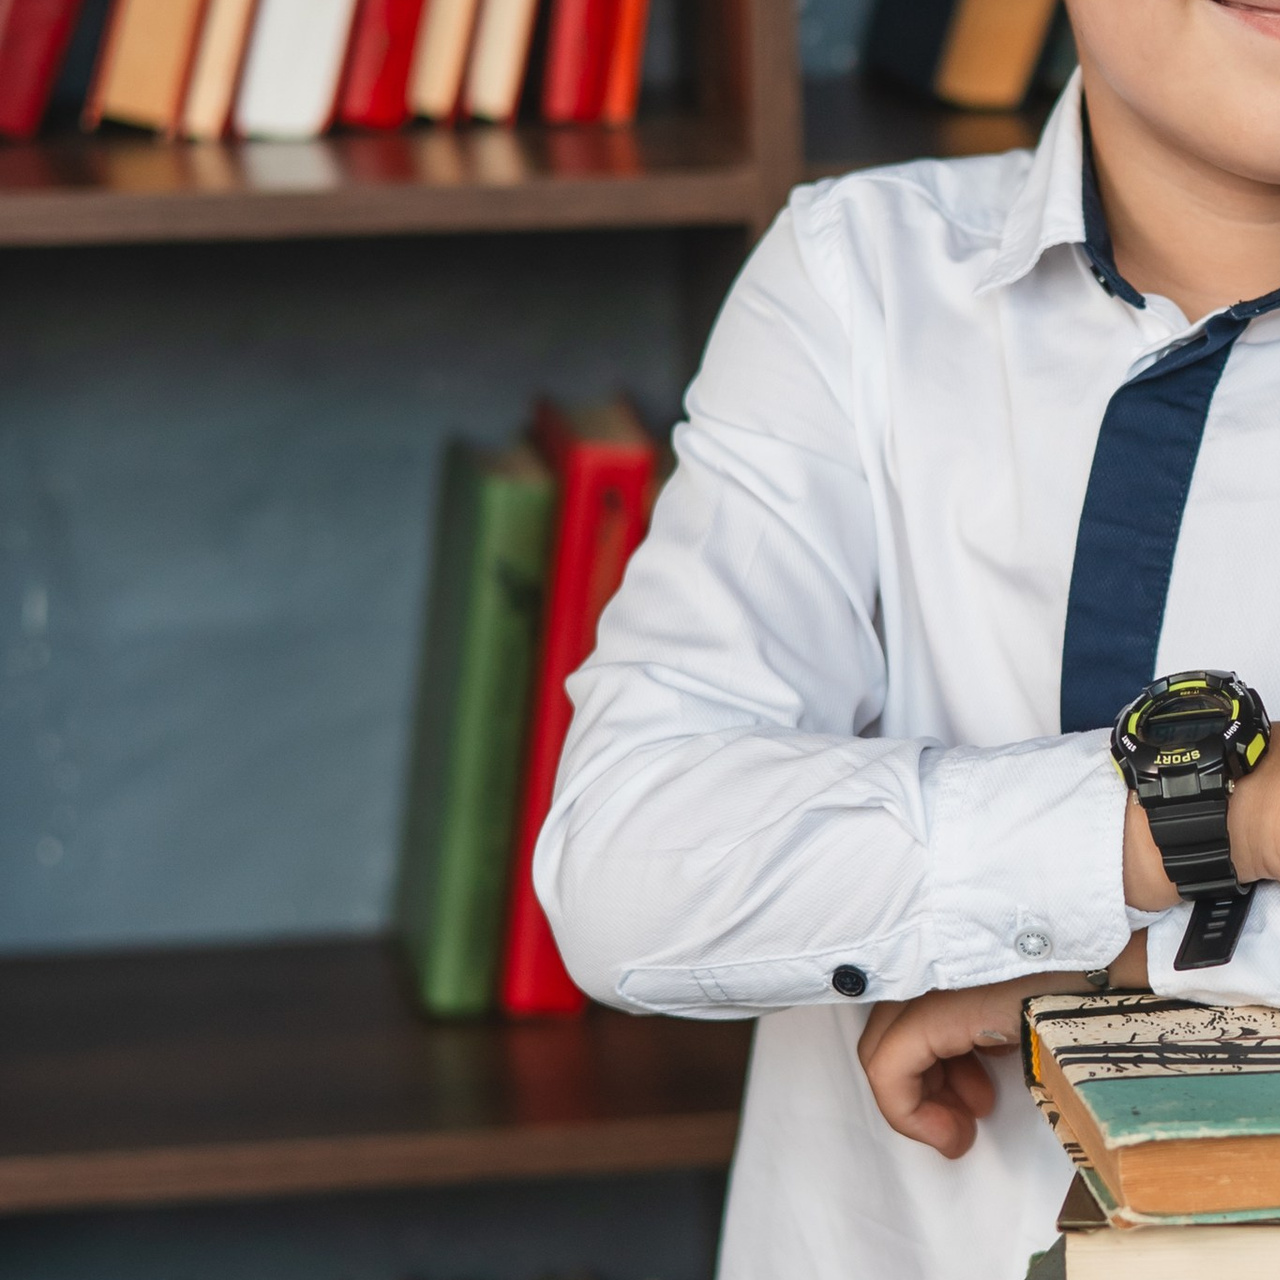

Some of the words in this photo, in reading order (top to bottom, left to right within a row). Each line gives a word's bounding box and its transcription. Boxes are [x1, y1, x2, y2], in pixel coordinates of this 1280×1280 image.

[1223, 720, 1241, 740] LIGHT
[1121, 734, 1138, 753] START
[1154, 749, 1201, 765] SPORT
